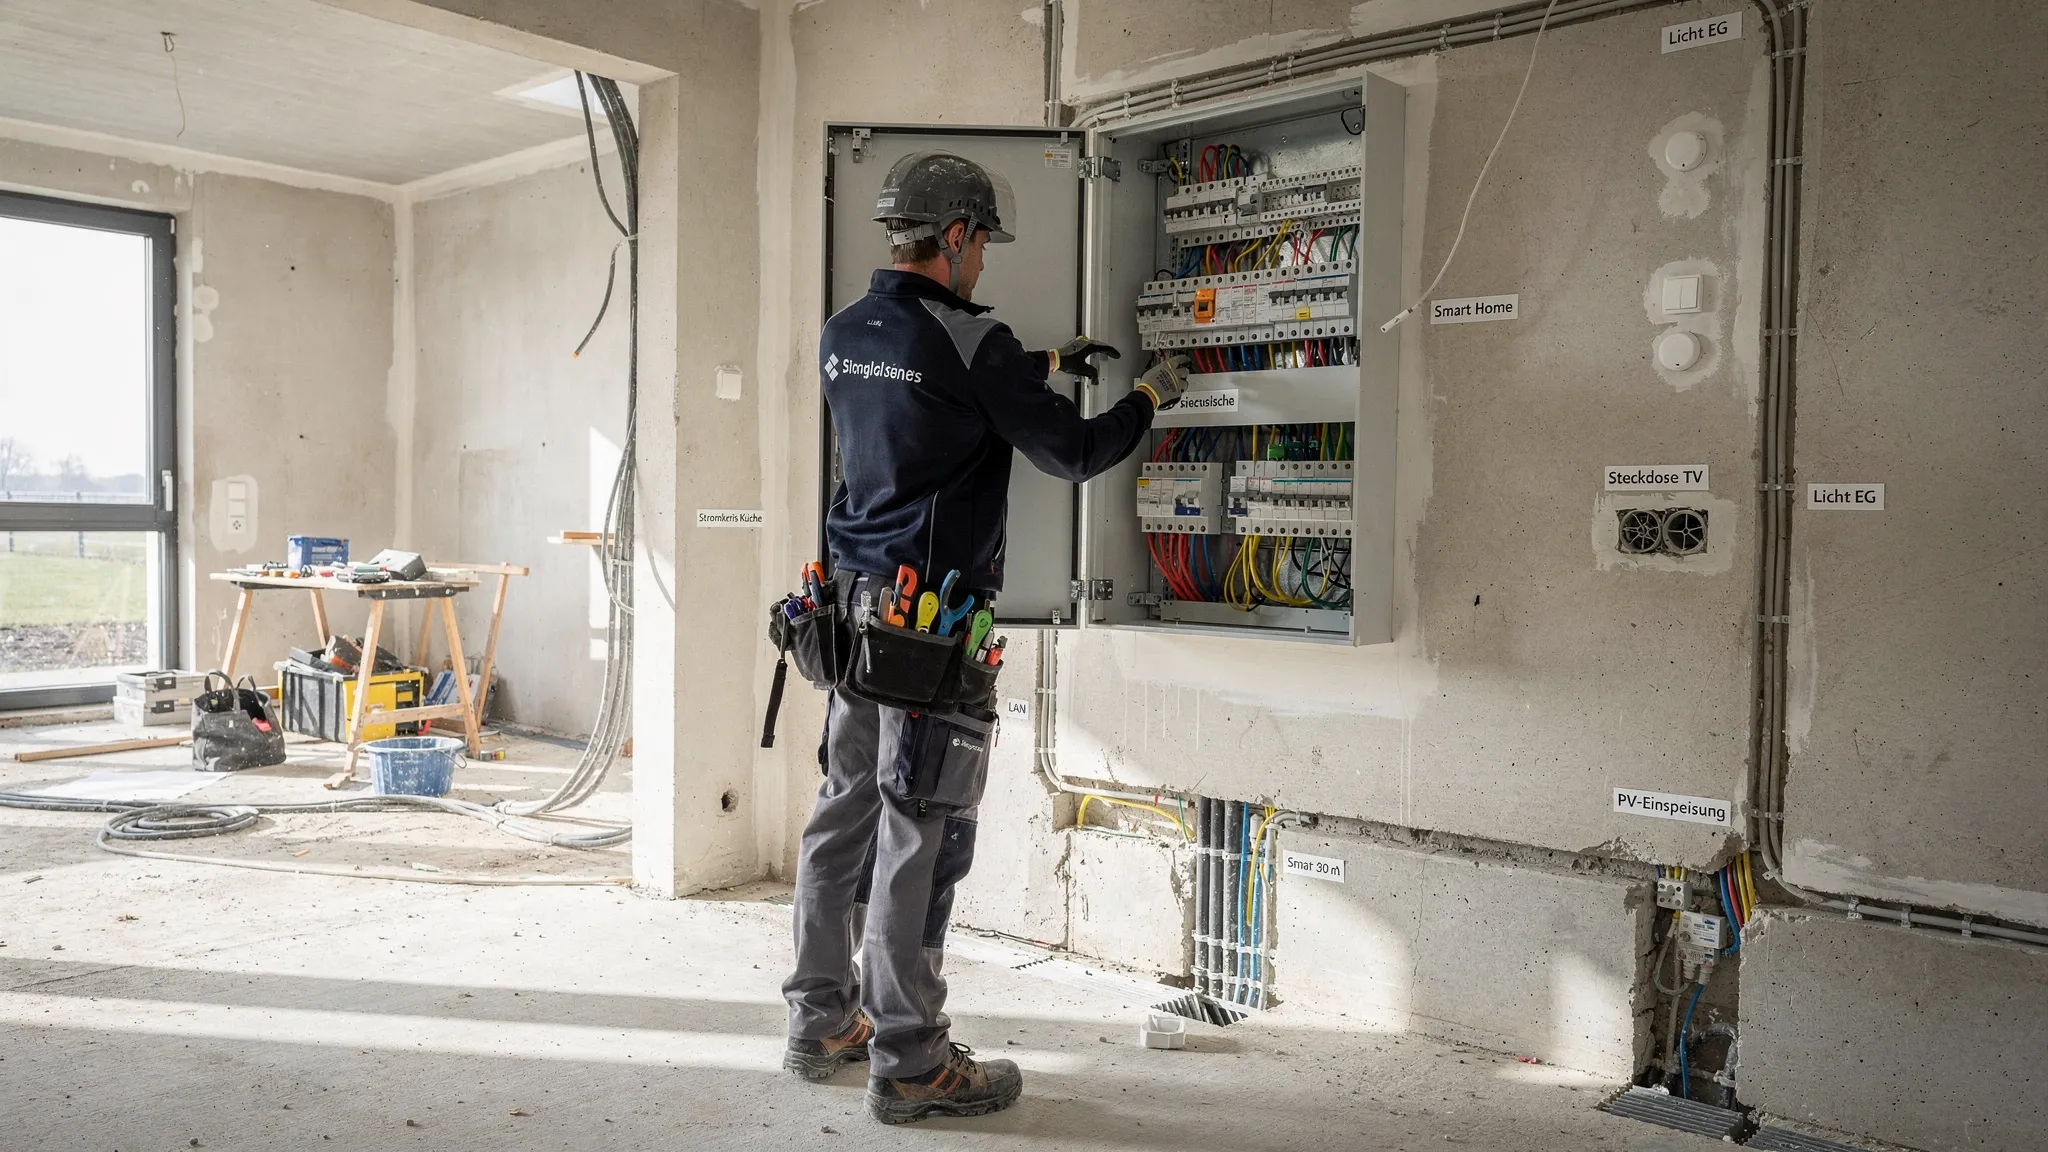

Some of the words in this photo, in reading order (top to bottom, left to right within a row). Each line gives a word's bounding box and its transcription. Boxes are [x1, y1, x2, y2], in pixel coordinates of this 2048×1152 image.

[1669, 26, 1704, 45] Licht
[1708, 21, 1728, 37] EG
[1434, 304, 1472, 318] Smart
[1475, 302, 1513, 315] Home
[1608, 469, 1679, 484] Steckdose
[1683, 470, 1703, 483] TV
[1814, 488, 1851, 503] Licht
[1855, 490, 1876, 503] EG
[1009, 701, 1026, 714] LAN
[1618, 793, 1725, 822] PV-Einspeisung
[1287, 857, 1314, 871] Smat
[1316, 862, 1329, 874] 30
